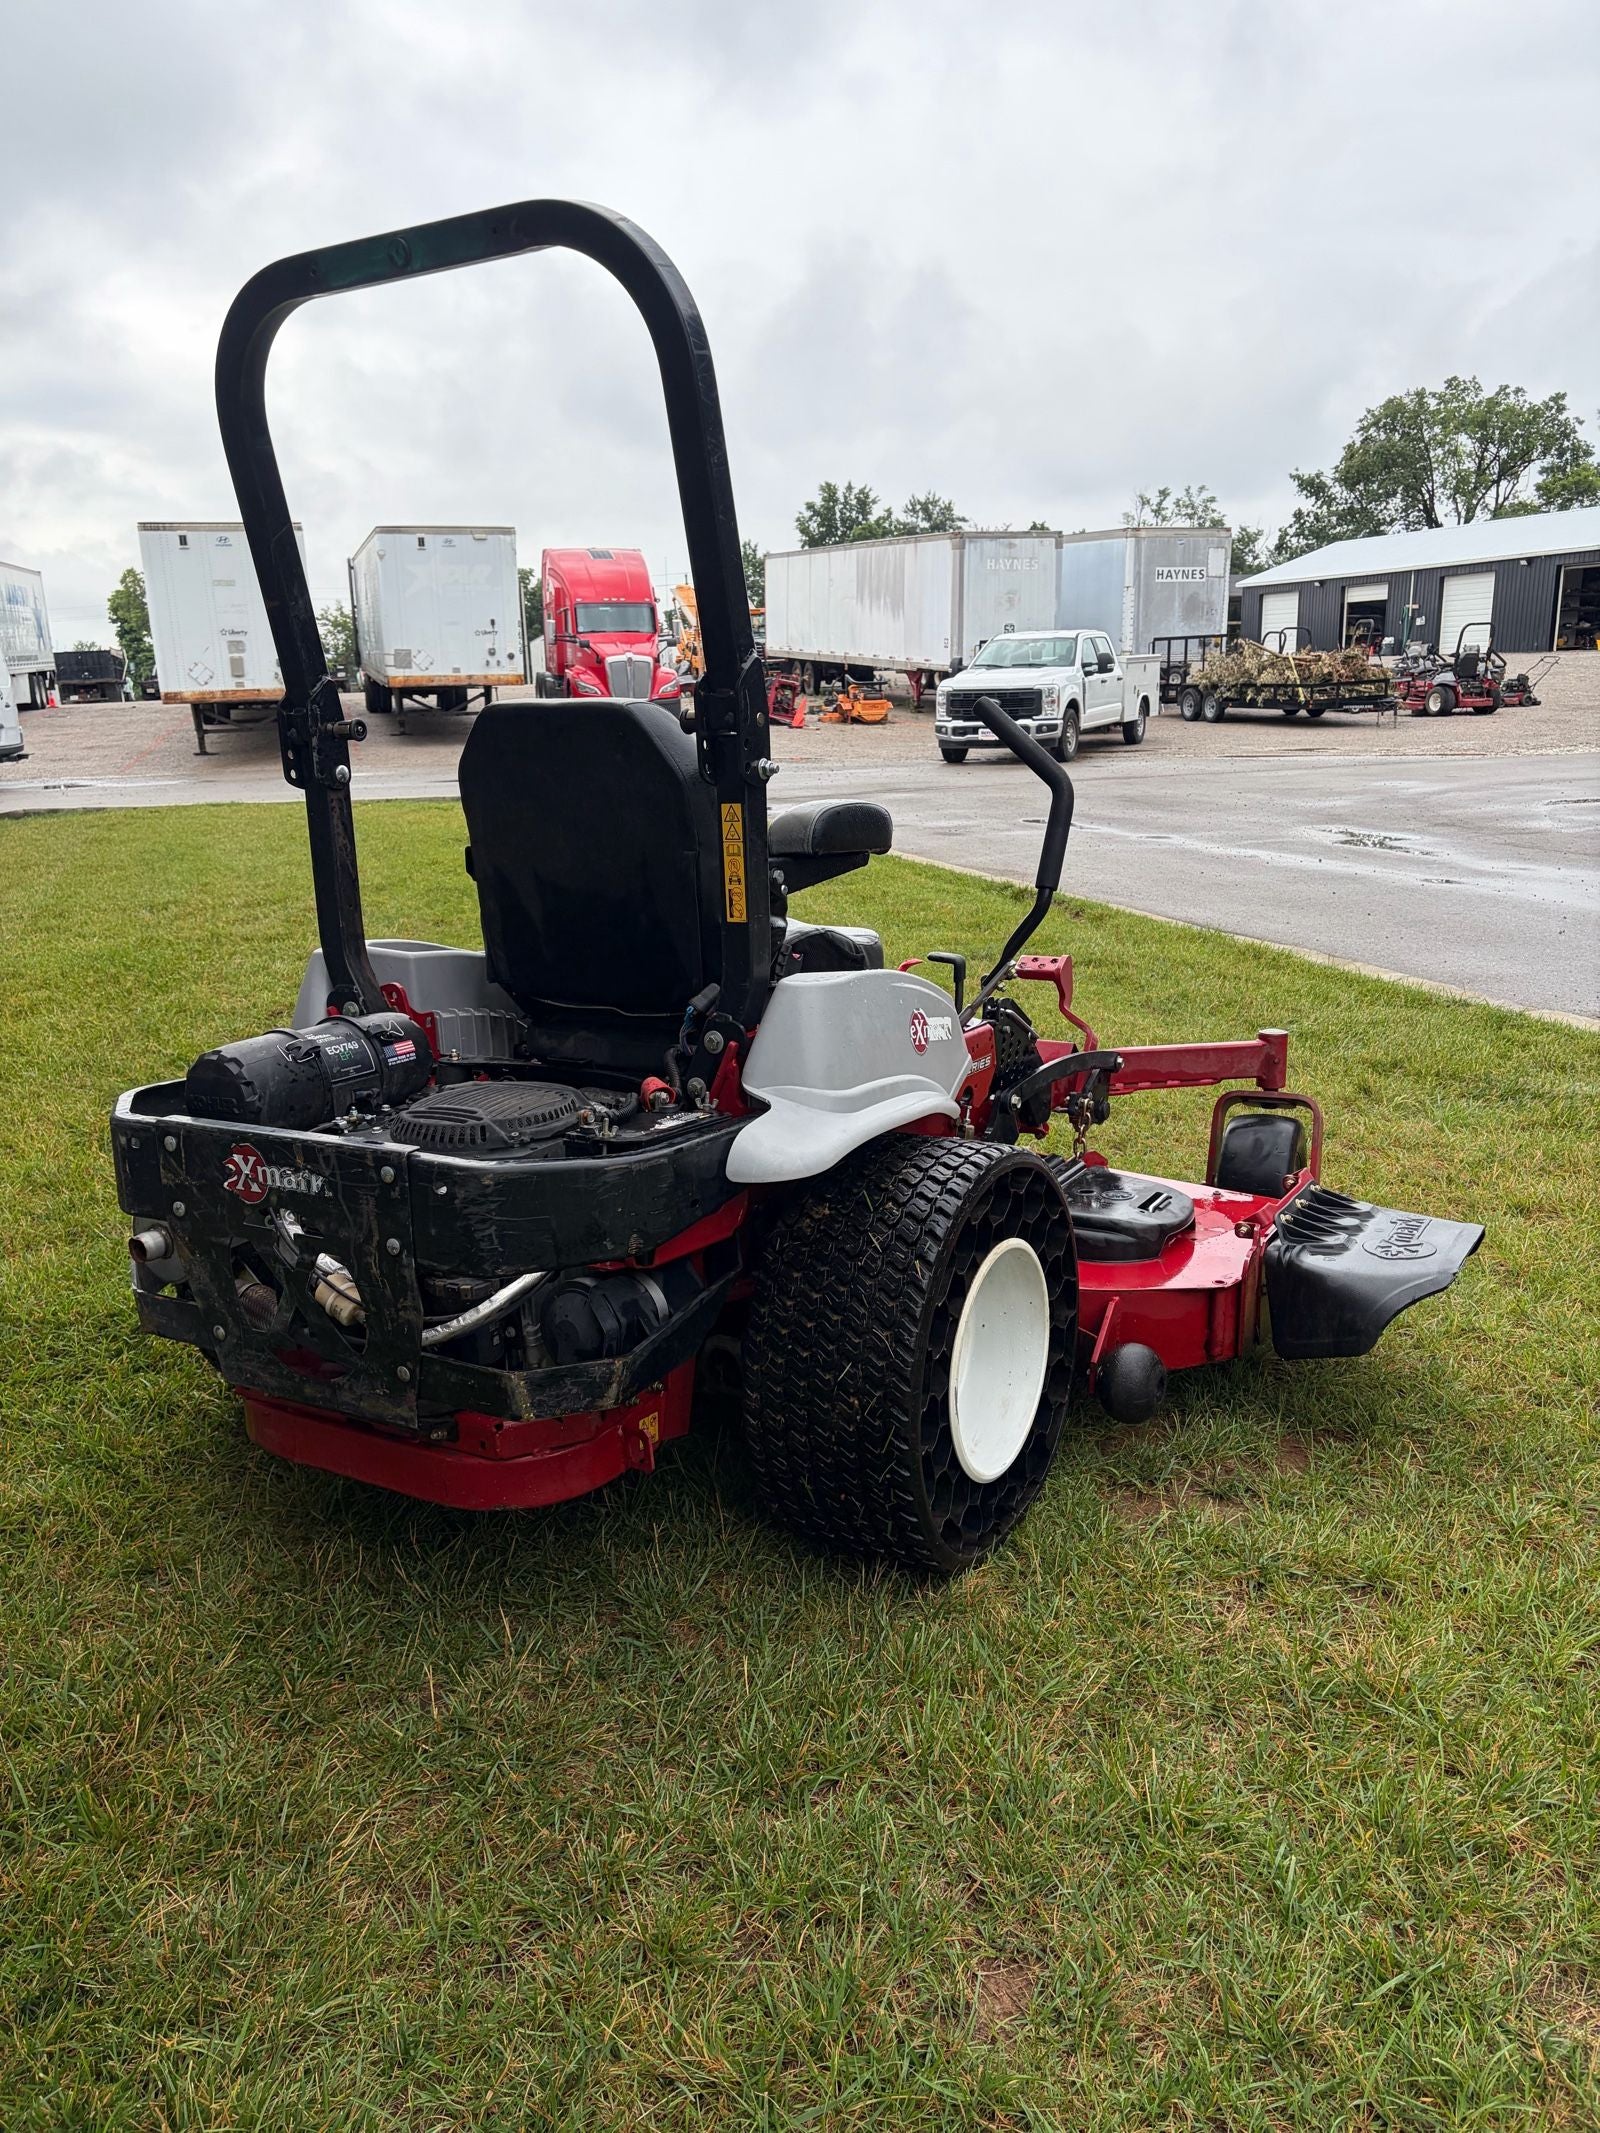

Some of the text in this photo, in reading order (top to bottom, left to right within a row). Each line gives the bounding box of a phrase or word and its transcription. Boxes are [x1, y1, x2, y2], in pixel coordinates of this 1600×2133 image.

[986, 559, 1039, 570] HAYNES
[1156, 569, 1205, 580] HAYNES
[325, 1040, 360, 1056] ECV749
[968, 1056, 992, 1074] RIES
